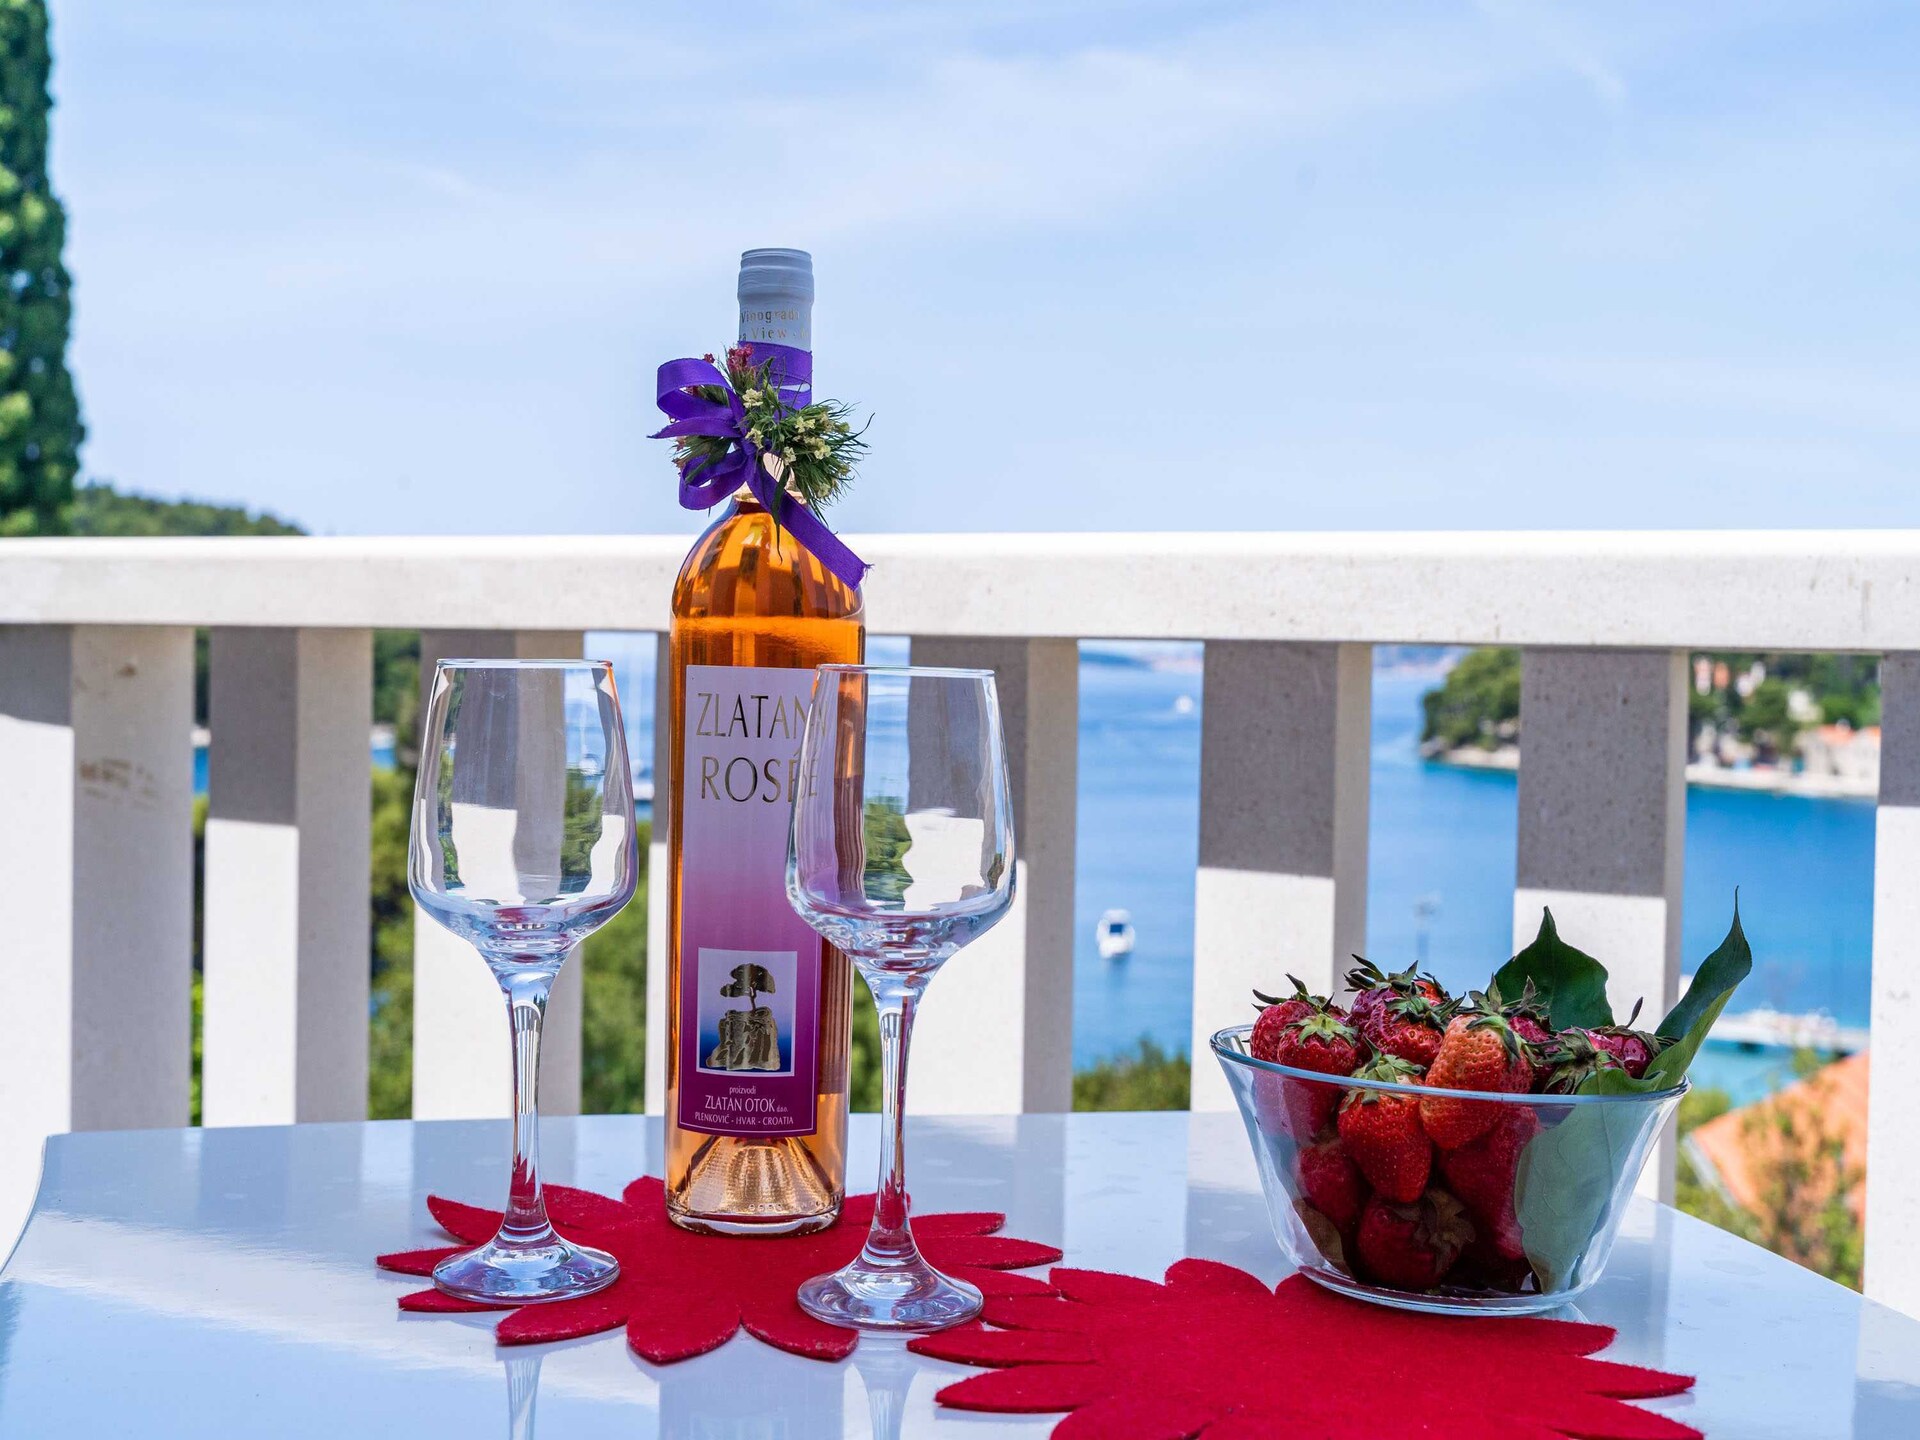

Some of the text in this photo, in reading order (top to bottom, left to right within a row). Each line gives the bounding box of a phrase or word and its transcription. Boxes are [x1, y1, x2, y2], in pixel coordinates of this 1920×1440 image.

[696, 693, 826, 739] ZLATAN
[729, 1085, 757, 1095] proizvodi
[705, 1095, 742, 1112] ZLATAN
[745, 1097, 776, 1112] OTOK
[695, 1111, 730, 1124] PLENKOVIĆ
[736, 1116, 756, 1125] HVAR
[762, 1116, 794, 1126] CROATIA
